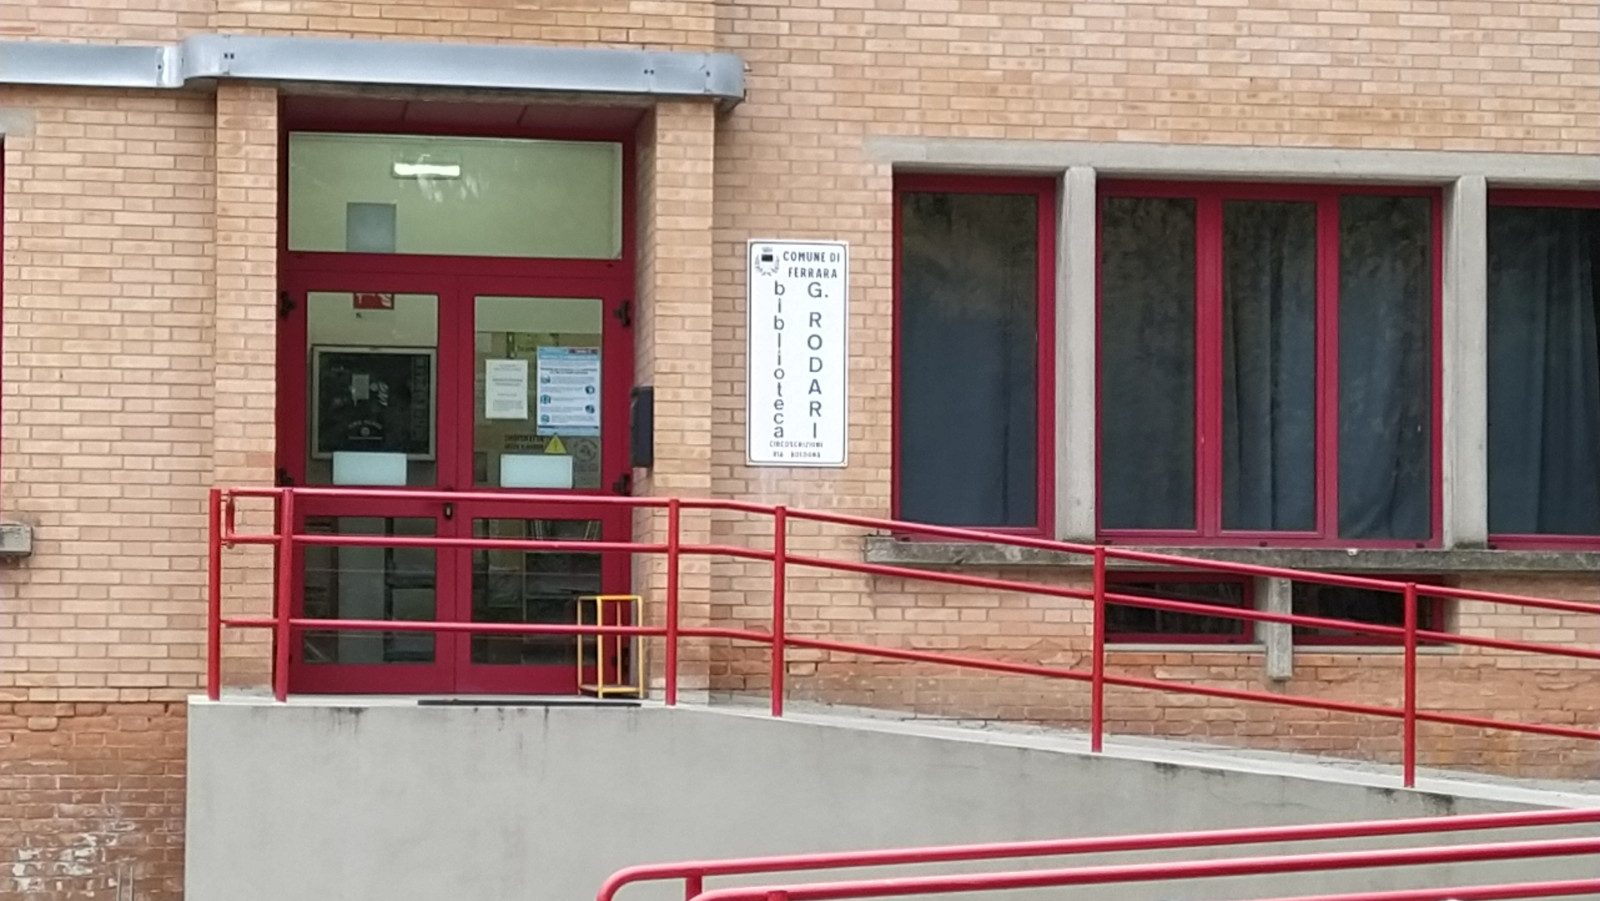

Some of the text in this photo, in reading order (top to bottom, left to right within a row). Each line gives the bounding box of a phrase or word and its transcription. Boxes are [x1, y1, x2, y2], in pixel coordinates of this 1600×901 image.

[783, 251, 840, 263] COMUNE DI
[788, 267, 837, 278] FERRARA
[773, 280, 785, 438] biblioteca
[807, 281, 828, 439] G. RODARI
